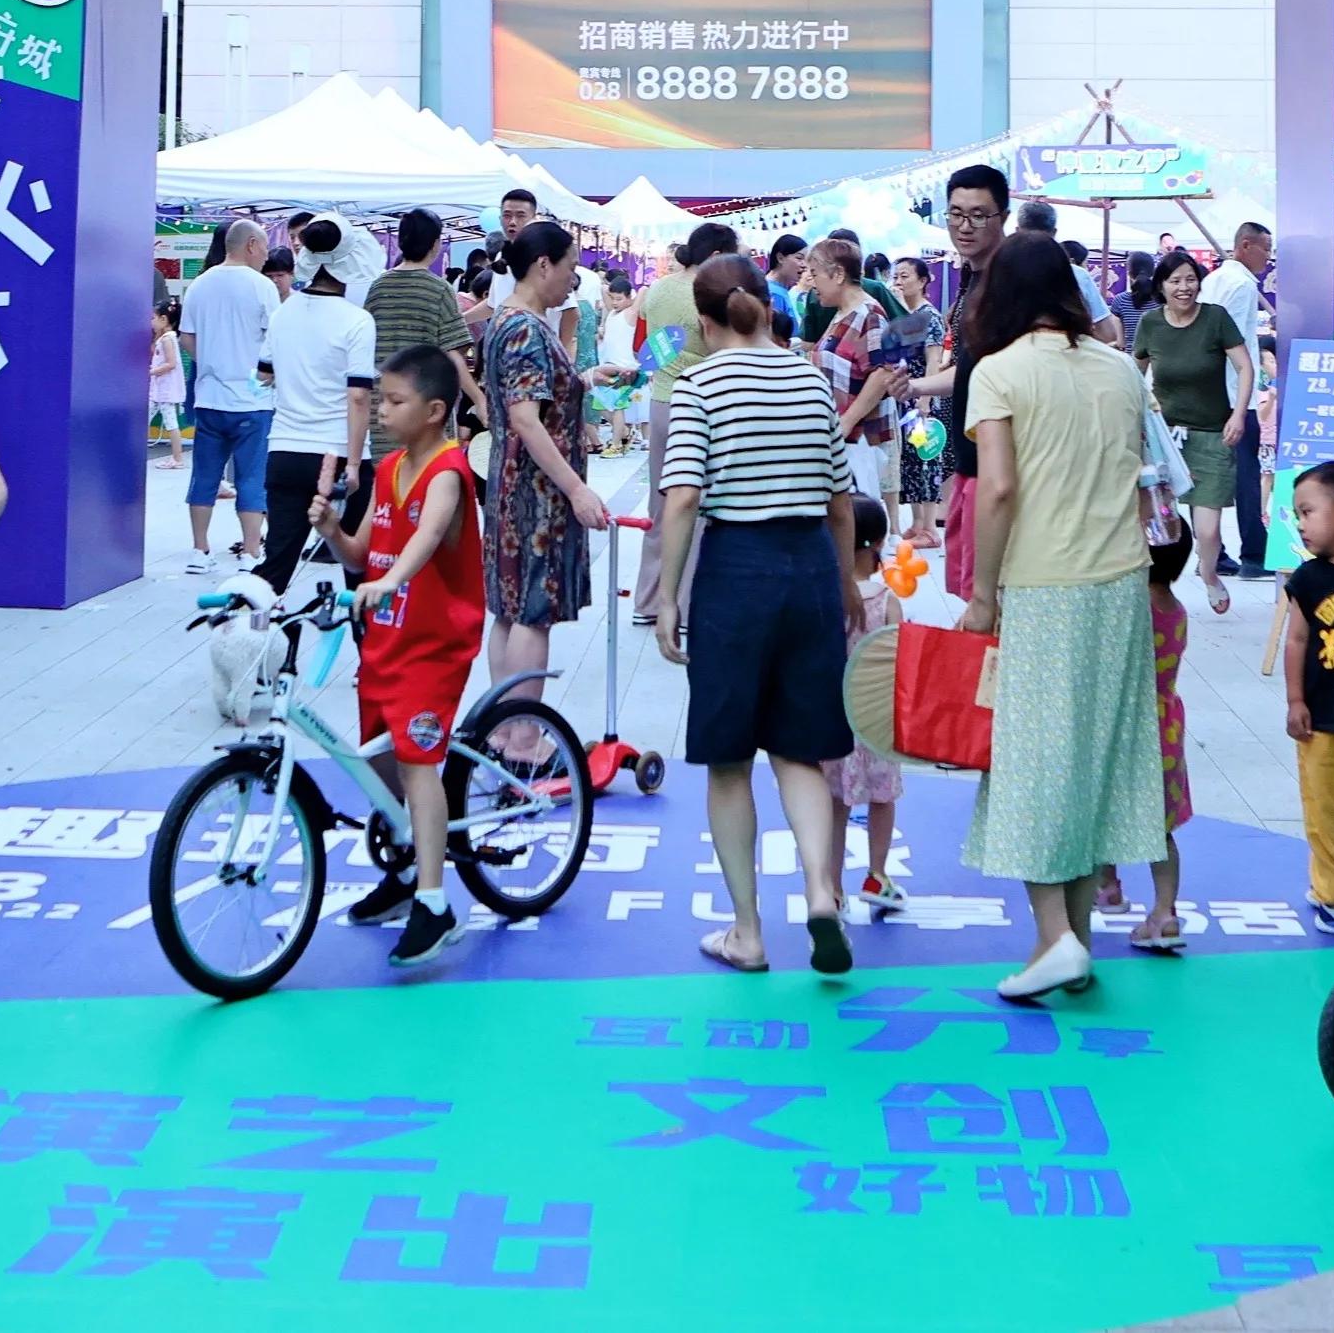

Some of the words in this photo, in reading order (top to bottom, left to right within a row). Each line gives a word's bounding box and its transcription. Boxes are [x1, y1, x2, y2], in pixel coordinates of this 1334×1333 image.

[578, 20, 696, 50] 招商销售
[702, 20, 850, 51] 热力进行中
[578, 80, 622, 101] 028
[636, 65, 738, 100] 8888
[747, 66, 850, 100] 7888
[1298, 420, 1324, 436] 7.8
[1282, 441, 1308, 457] 7.9
[607, 1077, 1110, 1156] 文创
[793, 1161, 1131, 1218] 好物
[3, 1184, 593, 1289] 演出
